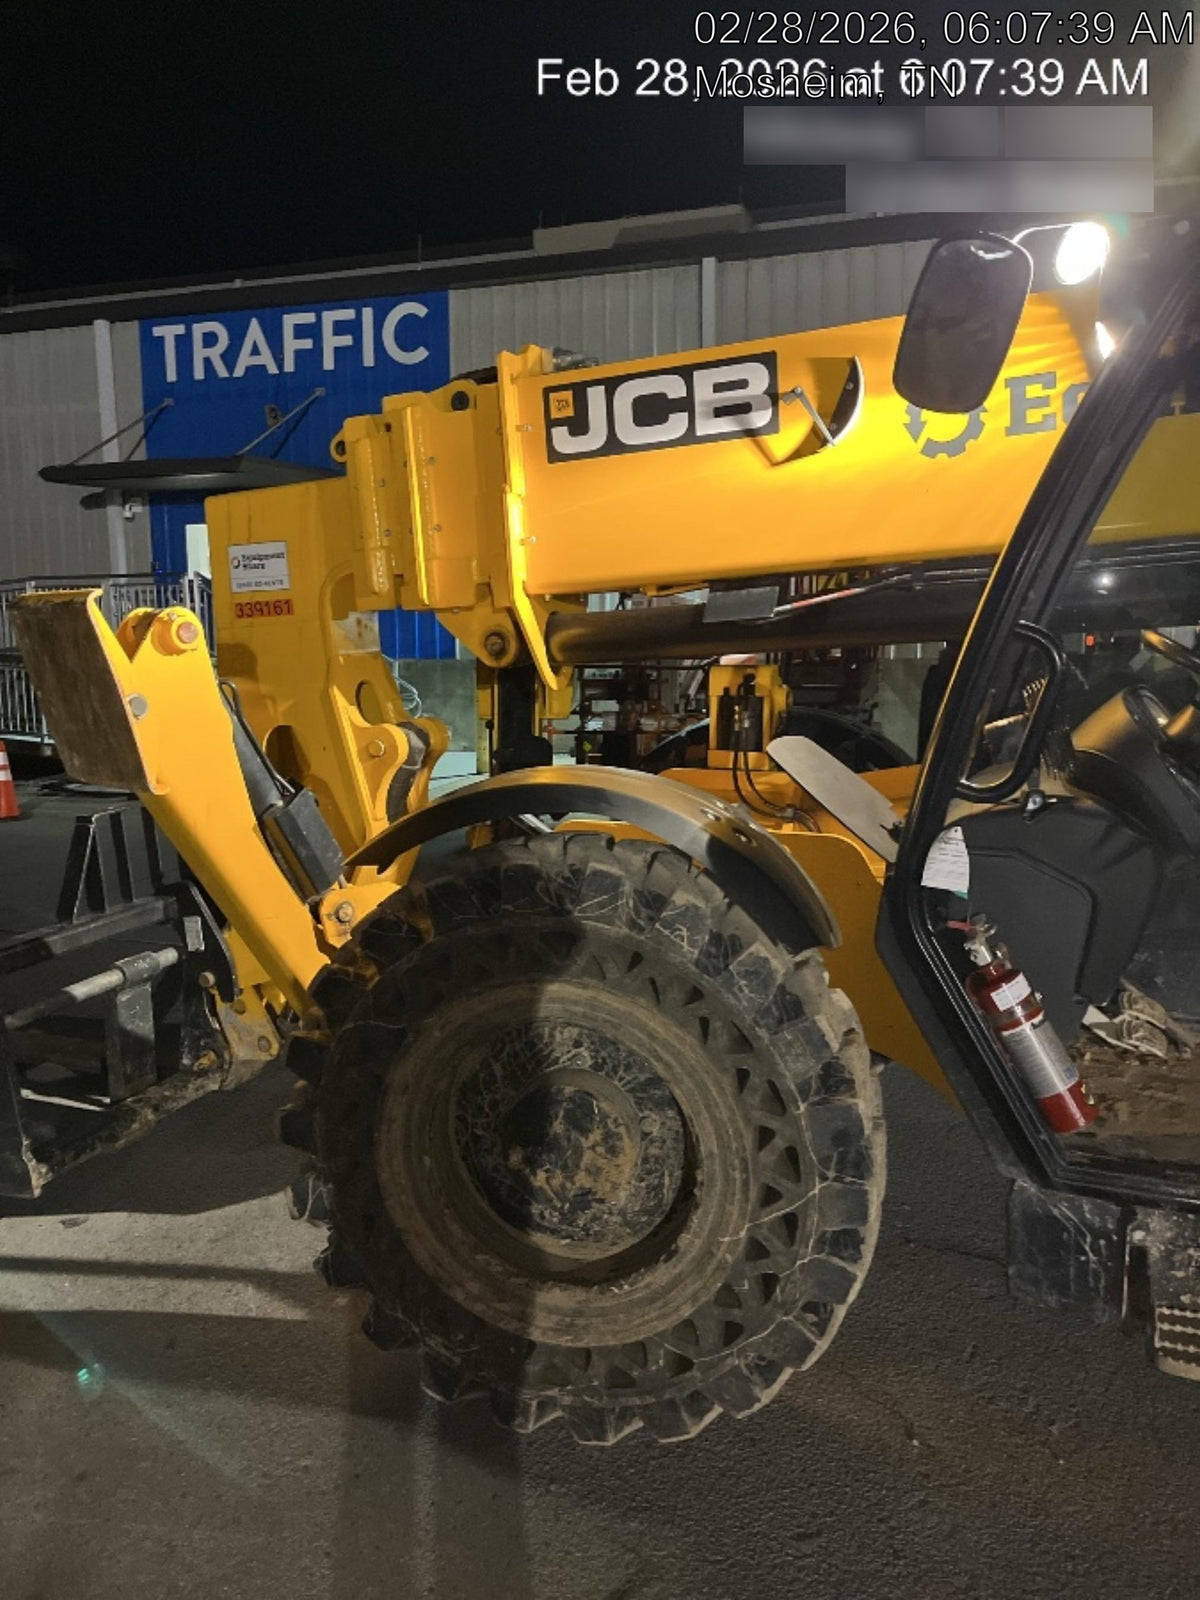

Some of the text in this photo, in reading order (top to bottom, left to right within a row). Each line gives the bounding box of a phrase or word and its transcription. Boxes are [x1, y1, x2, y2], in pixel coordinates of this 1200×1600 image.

[152, 302, 430, 383] TRAFFIC
[551, 362, 773, 454] JCB
[235, 600, 292, 618] 339161
